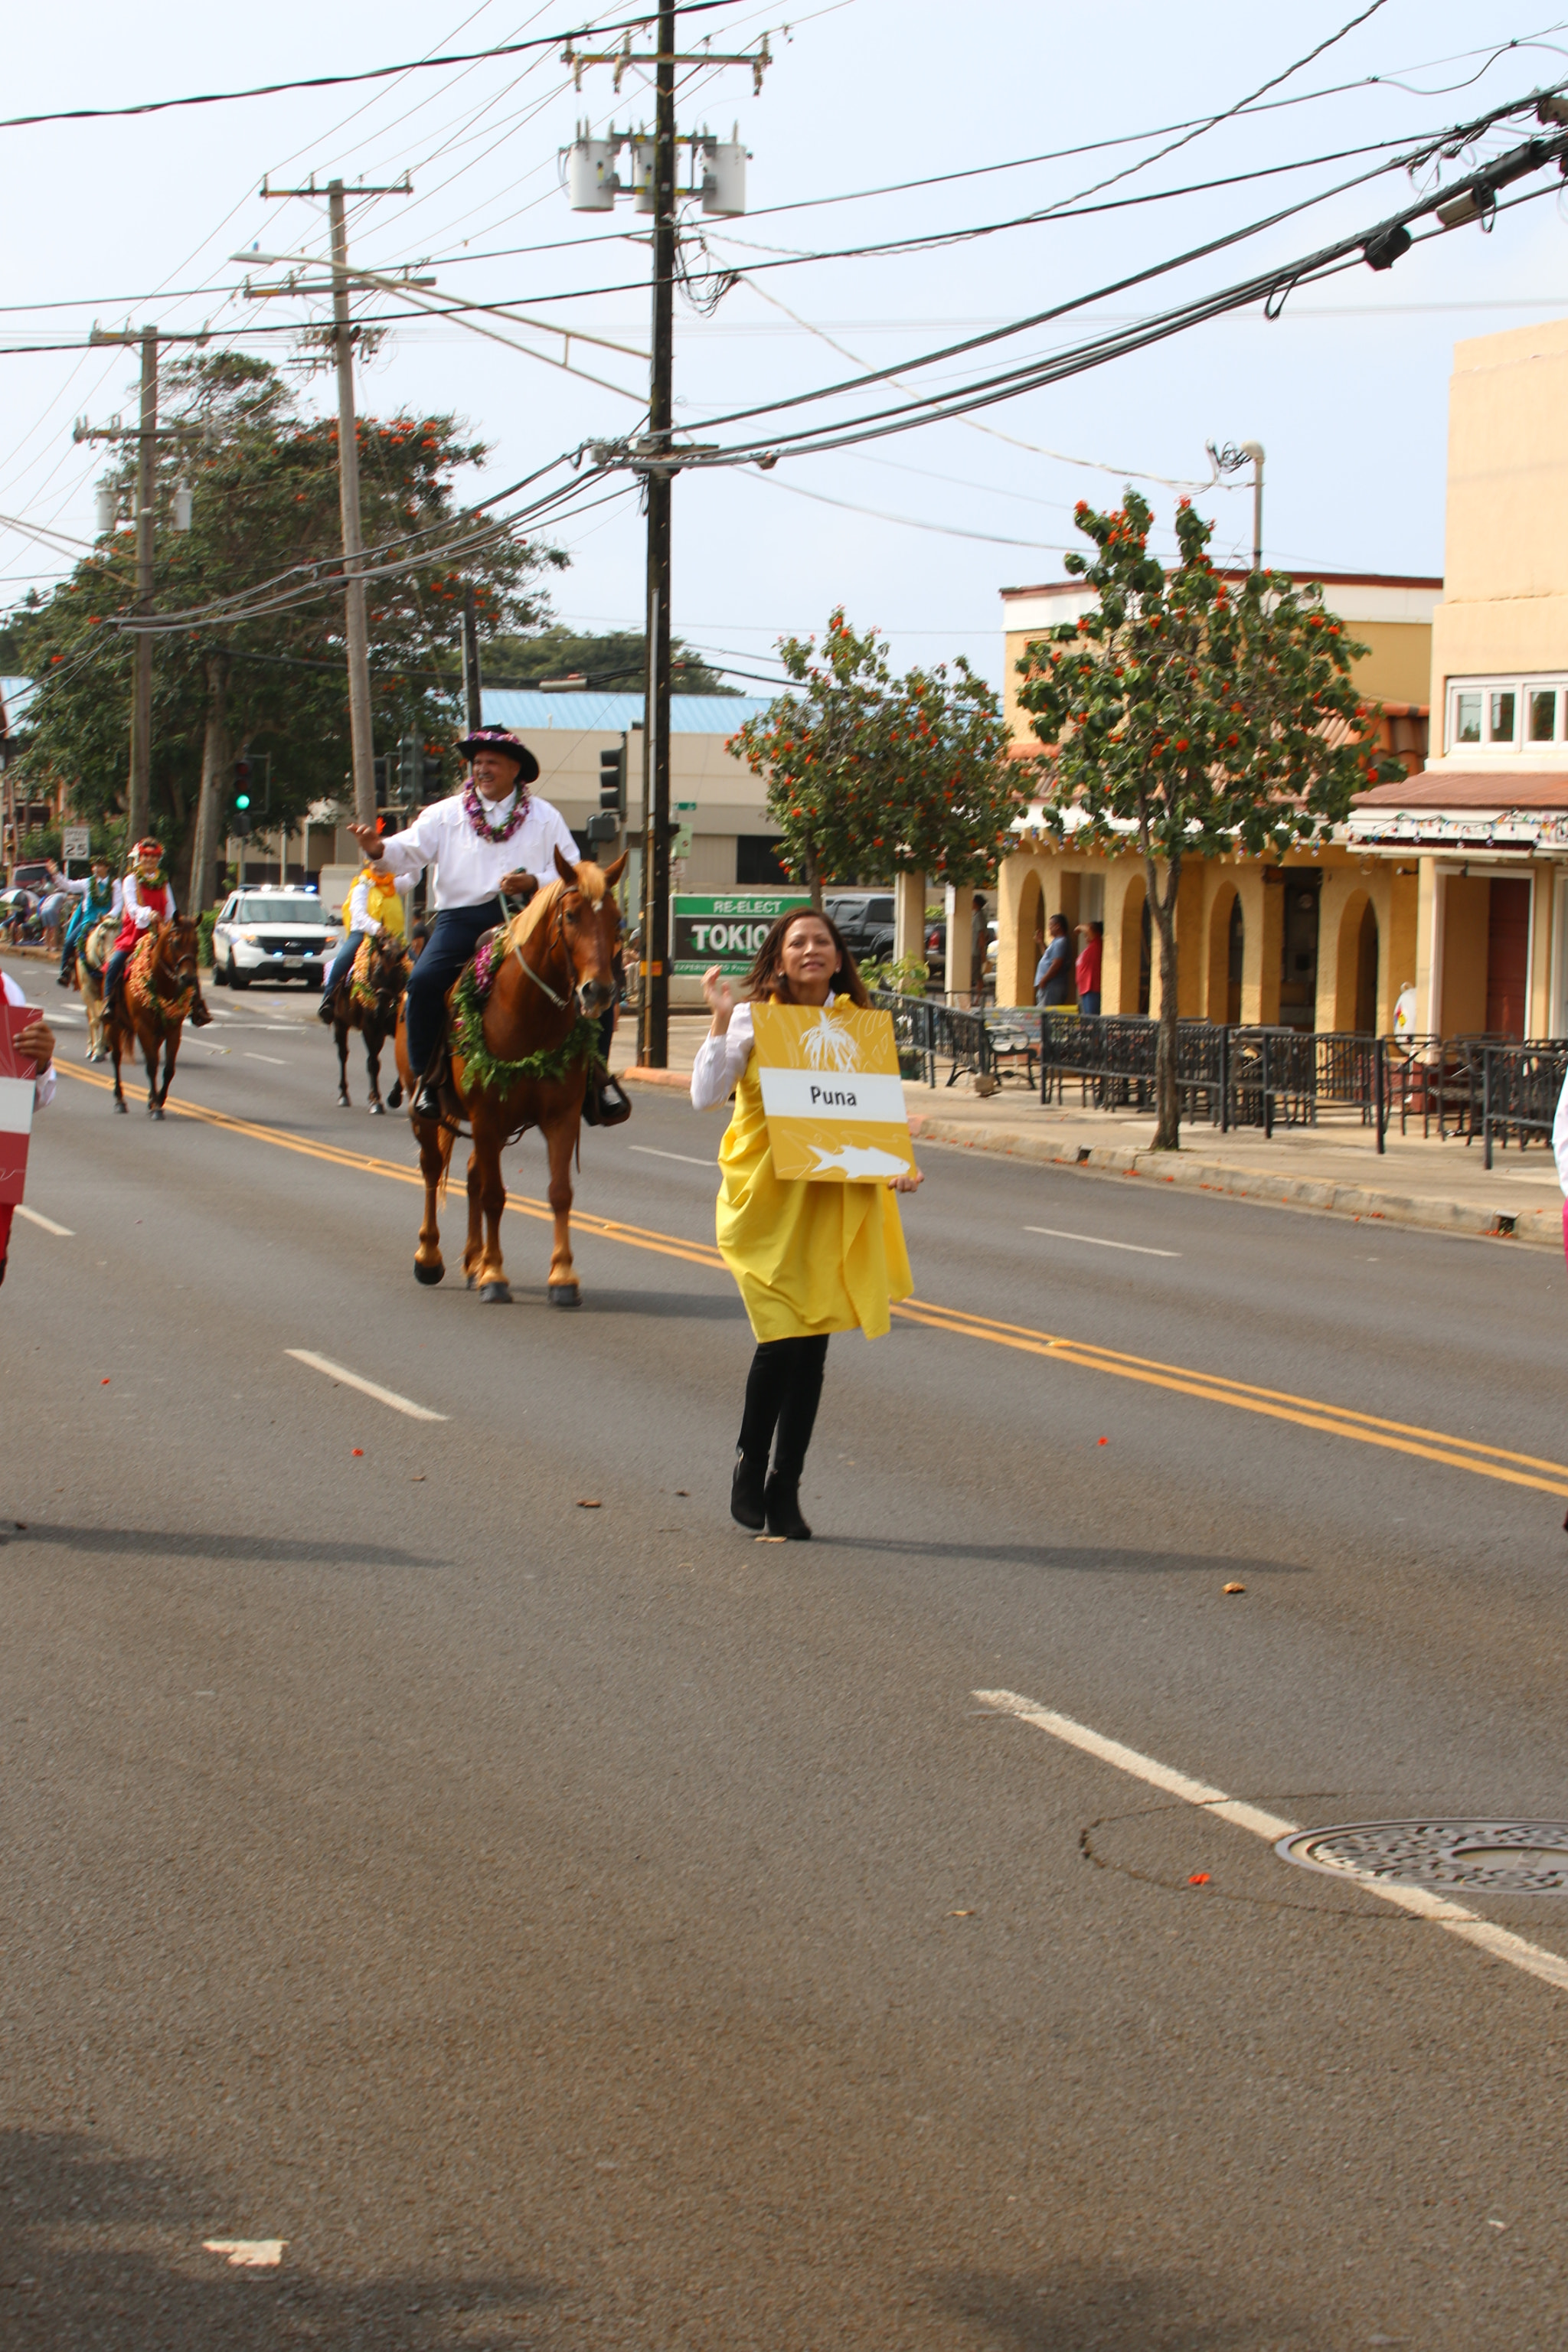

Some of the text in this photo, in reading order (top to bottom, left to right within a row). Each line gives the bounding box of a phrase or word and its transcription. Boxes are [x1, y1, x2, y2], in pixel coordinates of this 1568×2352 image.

[65, 843, 87, 856] 25
[714, 900, 782, 913] RE-ELECT
[691, 923, 773, 951] TOKIO
[810, 1086, 857, 1106] Puna
